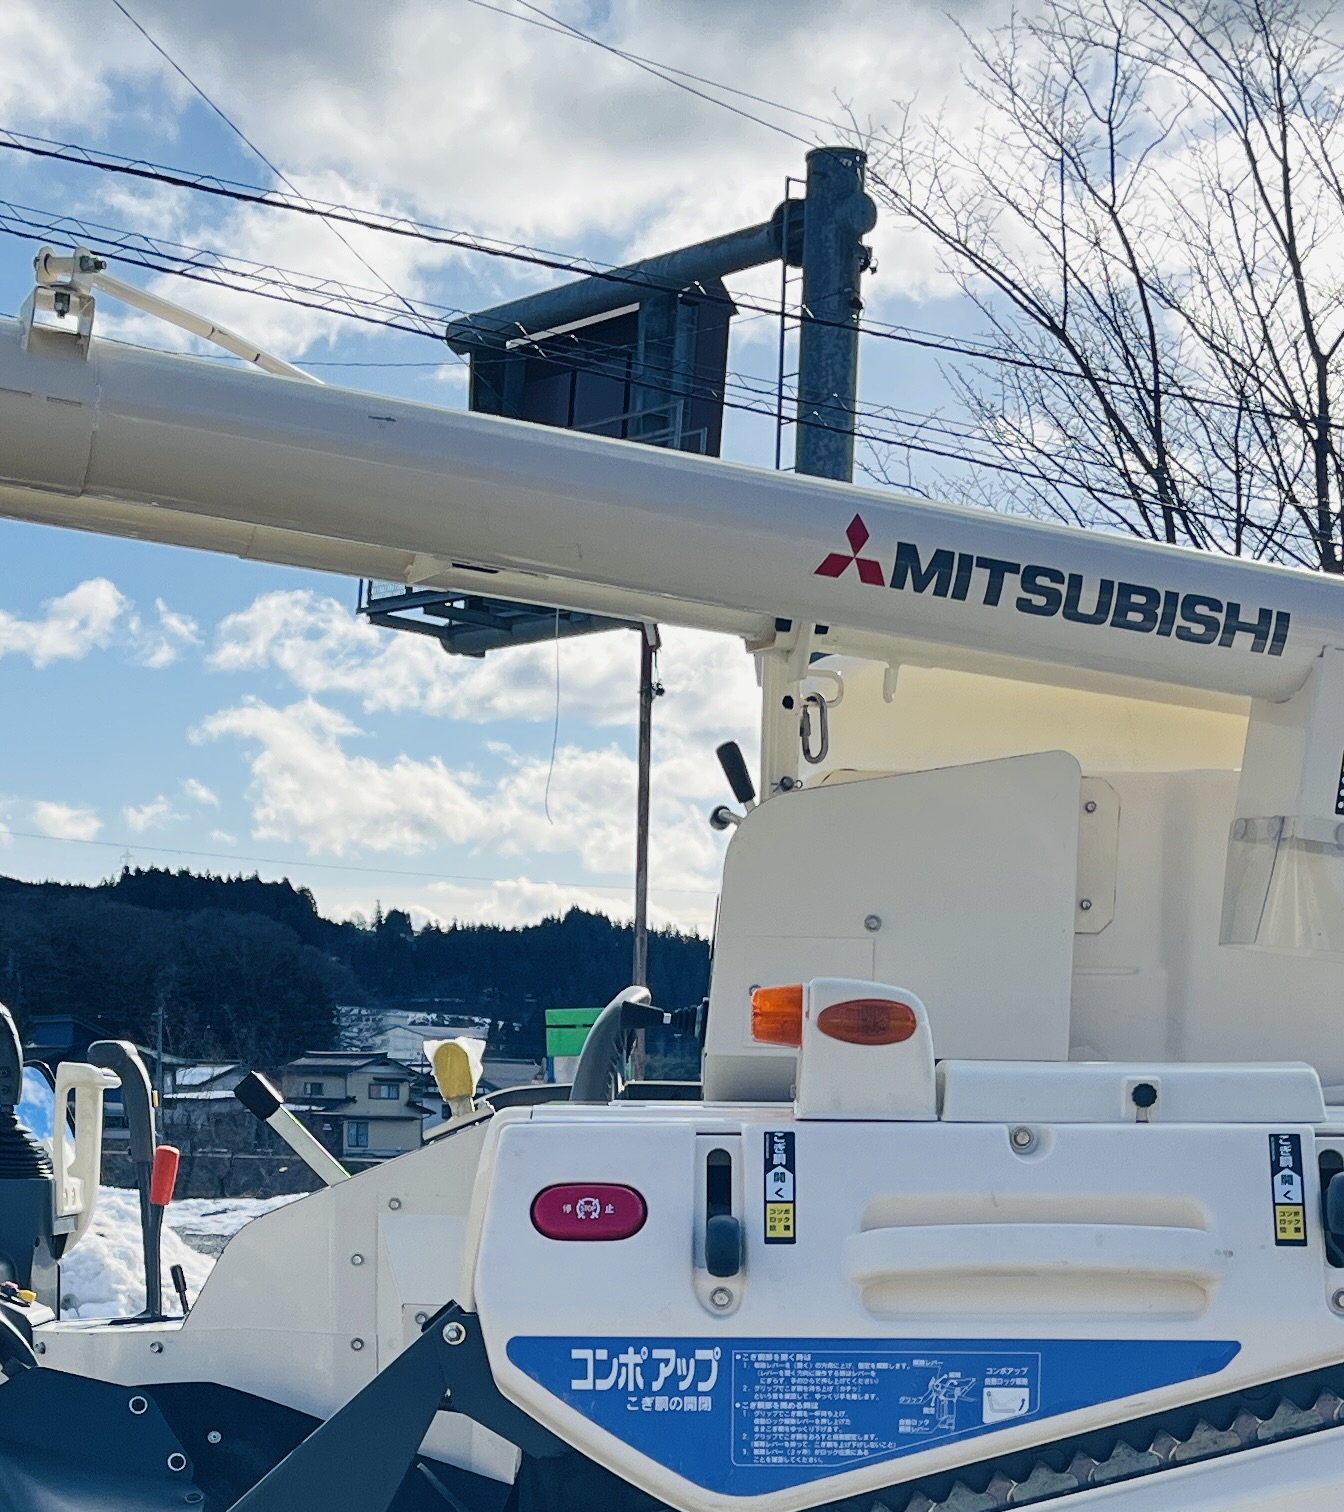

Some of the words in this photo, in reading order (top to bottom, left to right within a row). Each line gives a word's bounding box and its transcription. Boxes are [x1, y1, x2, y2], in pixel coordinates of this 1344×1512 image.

[889, 541, 1291, 657] MITSUBISHI
[570, 1346, 722, 1392] コンポアップ
